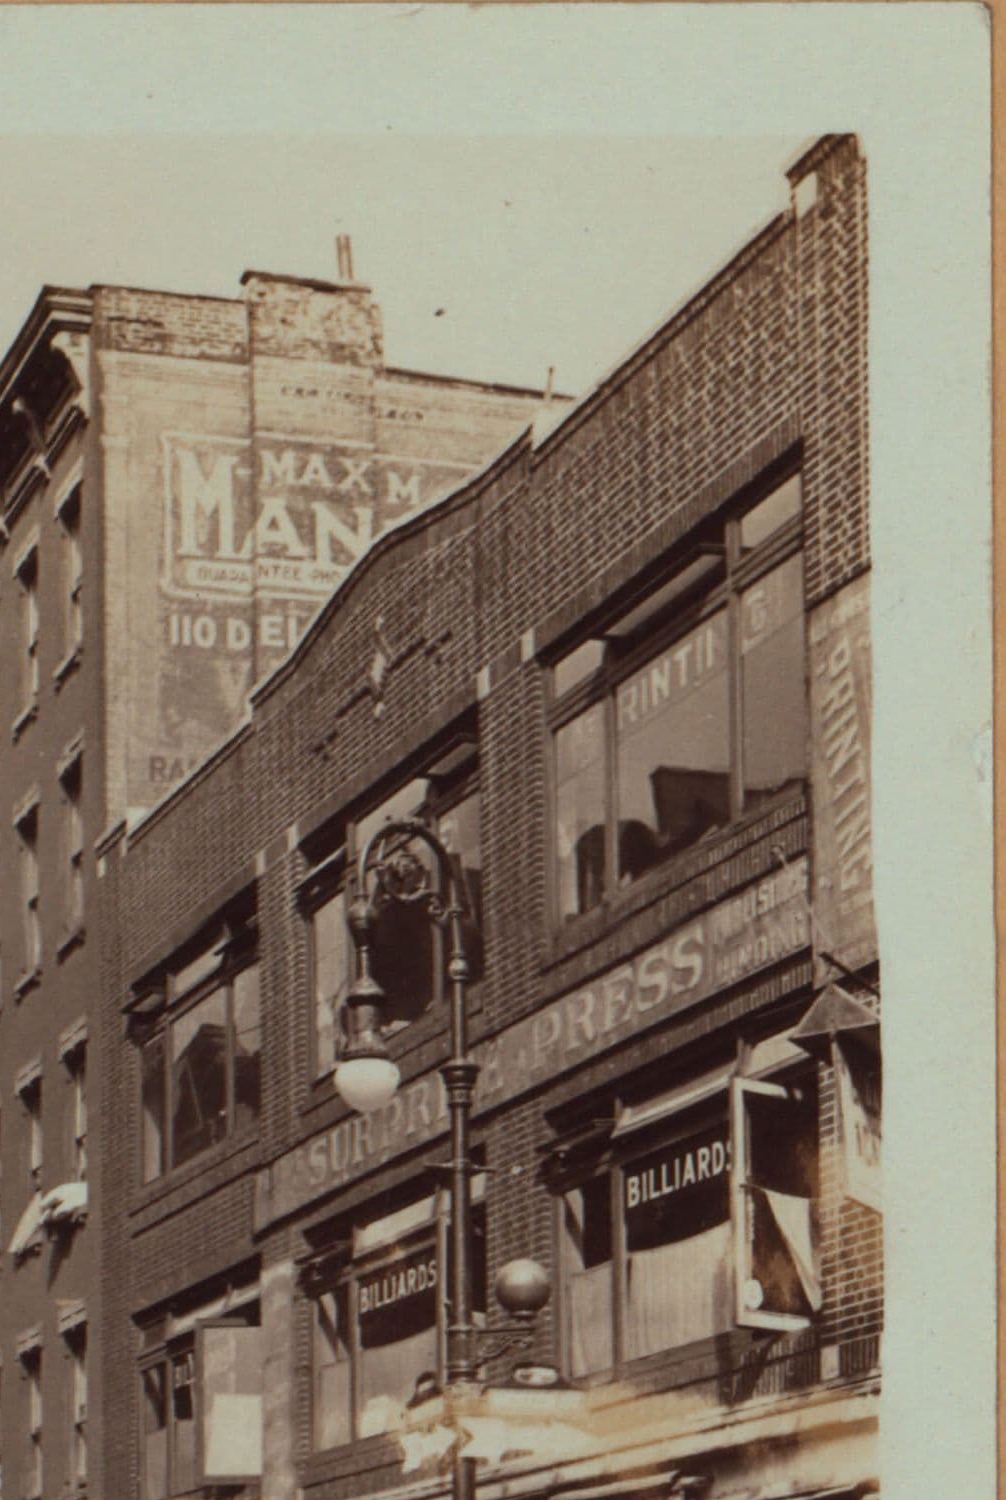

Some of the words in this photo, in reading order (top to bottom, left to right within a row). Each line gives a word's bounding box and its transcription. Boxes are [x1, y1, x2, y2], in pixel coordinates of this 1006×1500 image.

[260, 450, 372, 493] MAX
[169, 613, 217, 649] 110
[308, 1038, 505, 1187] SURPRIE
[532, 924, 707, 1072] PRESS
[359, 1259, 438, 1313] BILLIARDS
